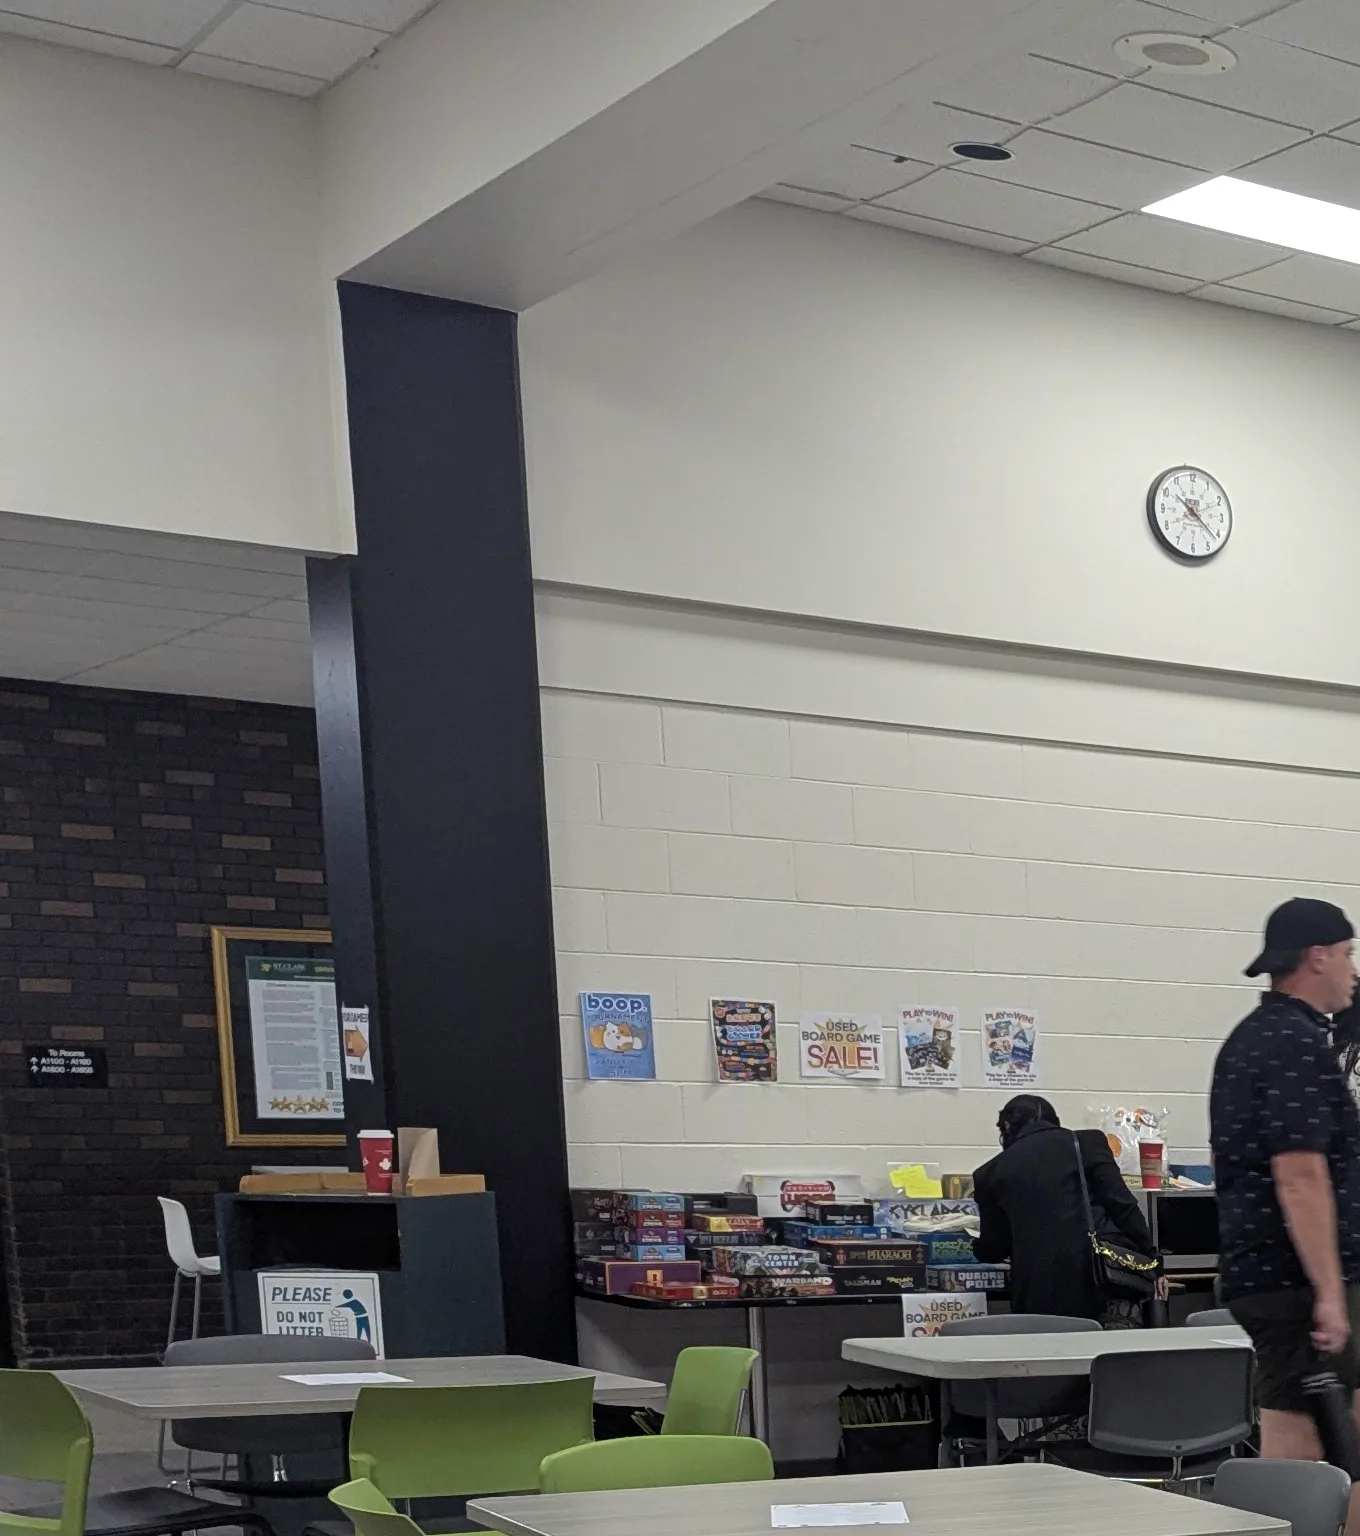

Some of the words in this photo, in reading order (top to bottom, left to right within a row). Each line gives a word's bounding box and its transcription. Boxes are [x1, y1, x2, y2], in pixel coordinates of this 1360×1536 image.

[902, 1008, 925, 1019] PLAY
[932, 1009, 954, 1022] WIN!
[985, 1011, 1007, 1022] PLAY
[1013, 1012, 1034, 1025] WIN!
[826, 1021, 858, 1032] USED
[802, 1031, 843, 1042] BOARD
[846, 1033, 881, 1044] GAME
[808, 1045, 880, 1071] SALE!
[867, 1250, 912, 1261] PHARAOH
[771, 1277, 833, 1287] WARBAND
[958, 1272, 1005, 1281] QUADRO
[966, 1280, 1005, 1289] POLIS
[271, 1287, 332, 1302] PLEASE
[930, 1302, 963, 1312] USED
[277, 1311, 294, 1323] DO
[298, 1311, 324, 1323] NOT
[906, 1313, 948, 1324] BOARD
[278, 1326, 325, 1336] LITTER
